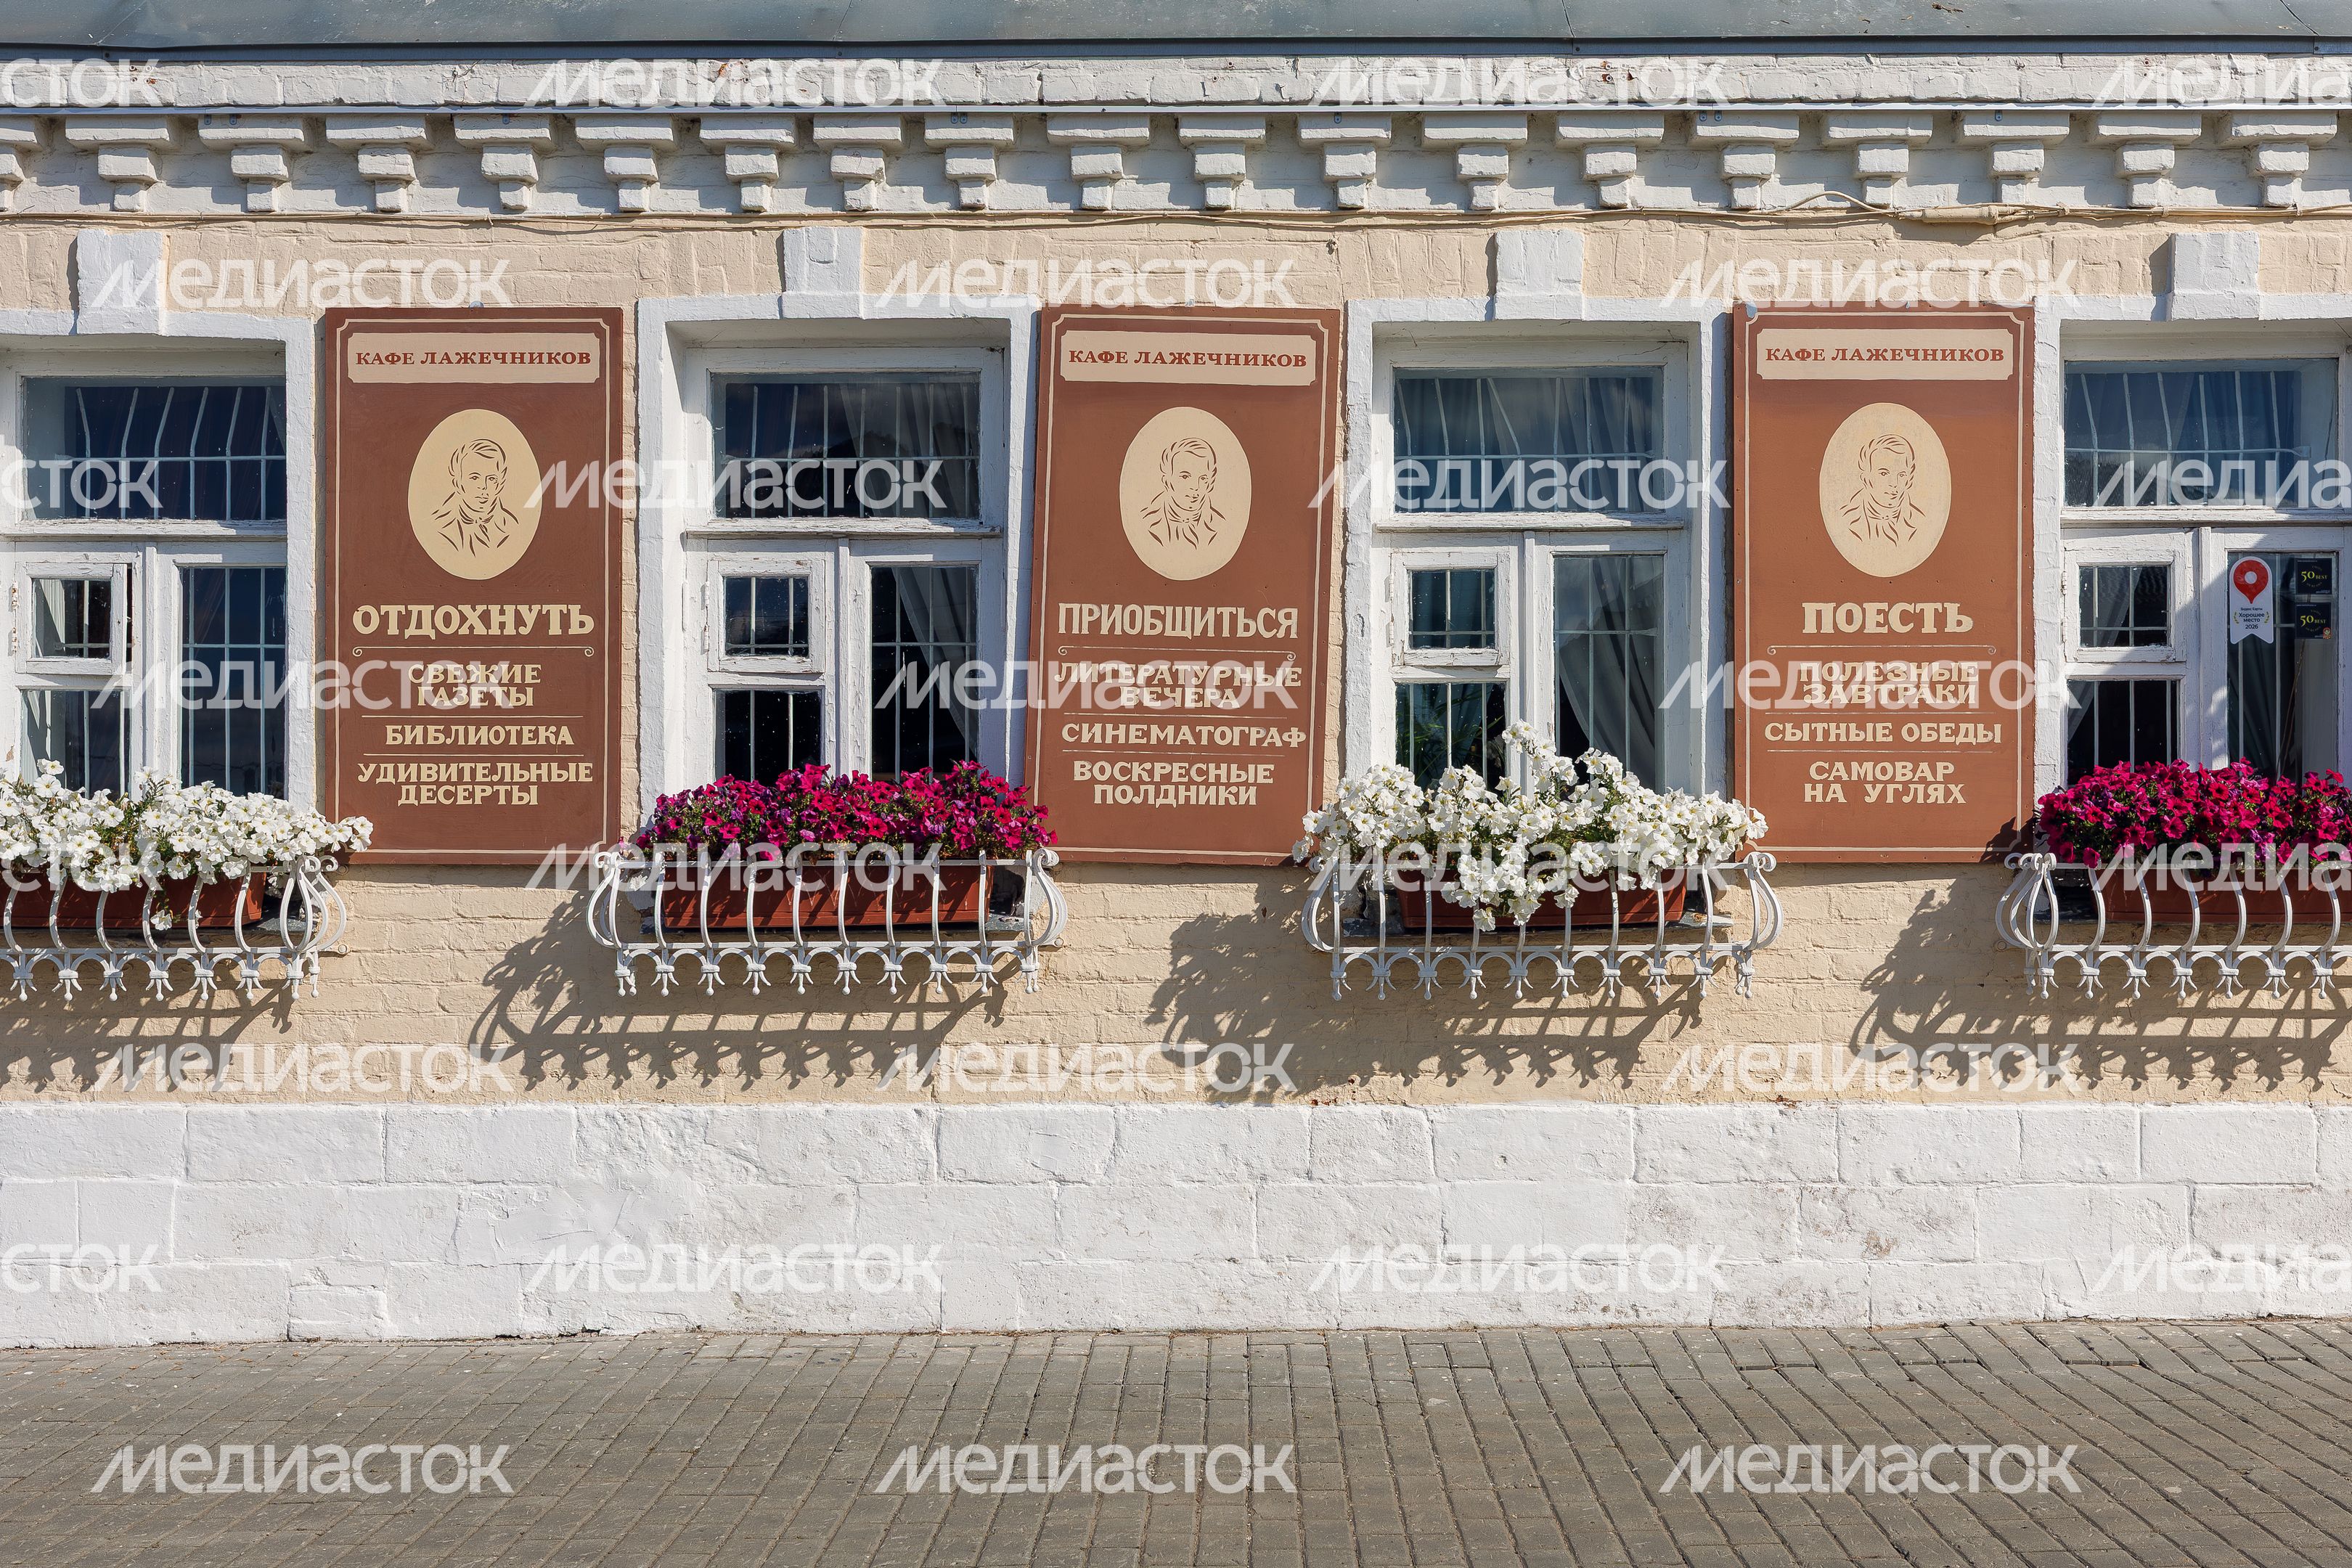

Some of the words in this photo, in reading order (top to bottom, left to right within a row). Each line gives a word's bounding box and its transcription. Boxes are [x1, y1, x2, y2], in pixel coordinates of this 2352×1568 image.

[356, 351, 415, 365] КАФЕ
[420, 351, 592, 365] ЛАЖЕЧНИКОВ
[1069, 350, 1128, 364] КАФЕ
[1134, 351, 1307, 367] ЛАЖЕЧНИКОВ
[1765, 348, 1825, 362] КАФЕ
[1831, 348, 2004, 362] ЛАЖЕЧНИКОВ
[2301, 571, 2315, 583] 50
[352, 605, 595, 640] ОТДОХНУТЬ
[1058, 603, 1299, 640] ПРИОБЩИТЬСЯ
[1802, 602, 1973, 634] ПОЕСТЬ
[2300, 615, 2314, 627] 50
[408, 663, 542, 684] СВЕЖИЕ
[1054, 662, 1302, 687] ЛИТЕРАТУРНЫЕ
[1800, 661, 1979, 682] ПОЛЕЗНЫЕ
[417, 687, 534, 706] ГАЗЕТЫ
[1119, 686, 1241, 709] ВЕЧЕРА
[1802, 683, 1976, 705] ЗАВТРАКИ
[385, 725, 574, 746] БИБЛИОТЕКА
[1061, 722, 1307, 748] СИНЕМАТОГРАФ
[1764, 722, 1894, 742] СЫТНЫЕ
[1900, 723, 2002, 746] ОБЕДЫ
[357, 762, 593, 785] УДИВИТЕЛЬНЫЕ
[1073, 760, 1275, 784] ВОСКРЕСНЫЕ
[1809, 761, 1954, 782] САМОВАР
[398, 785, 539, 807] ДЕСЕРТЫ
[1093, 784, 1257, 809] ПОЛДНИКИ
[1804, 783, 1847, 804] НА
[1863, 783, 1967, 804] УГЛЯХ
